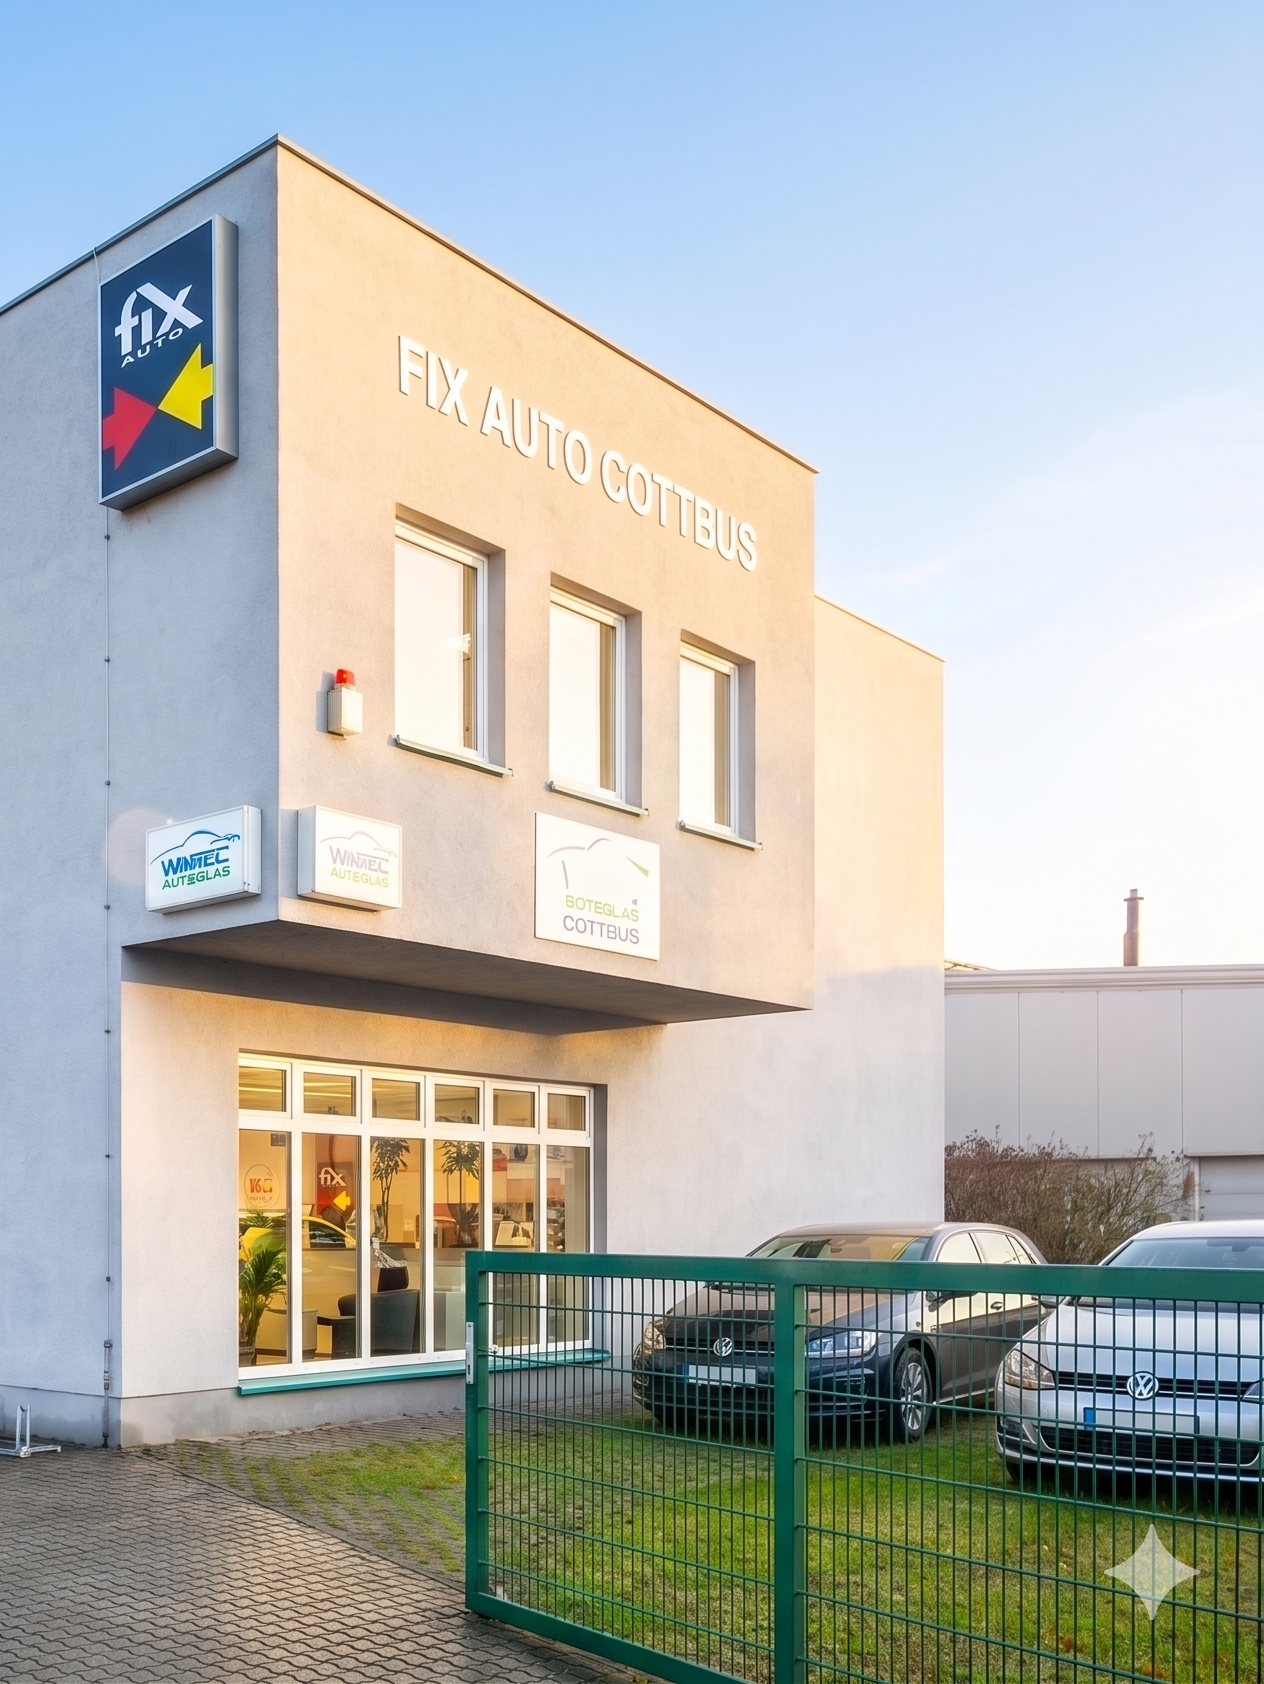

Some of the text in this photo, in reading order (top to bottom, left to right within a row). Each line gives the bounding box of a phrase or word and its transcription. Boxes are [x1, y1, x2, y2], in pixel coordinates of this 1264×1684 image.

[115, 282, 204, 356] fix
[121, 328, 183, 368] AUTO
[398, 335, 758, 572] FIX AUTO COTTBUS
[565, 894, 639, 922] BOTEGLAS
[563, 915, 640, 944] COTTBUS
[319, 1167, 346, 1187] fix
